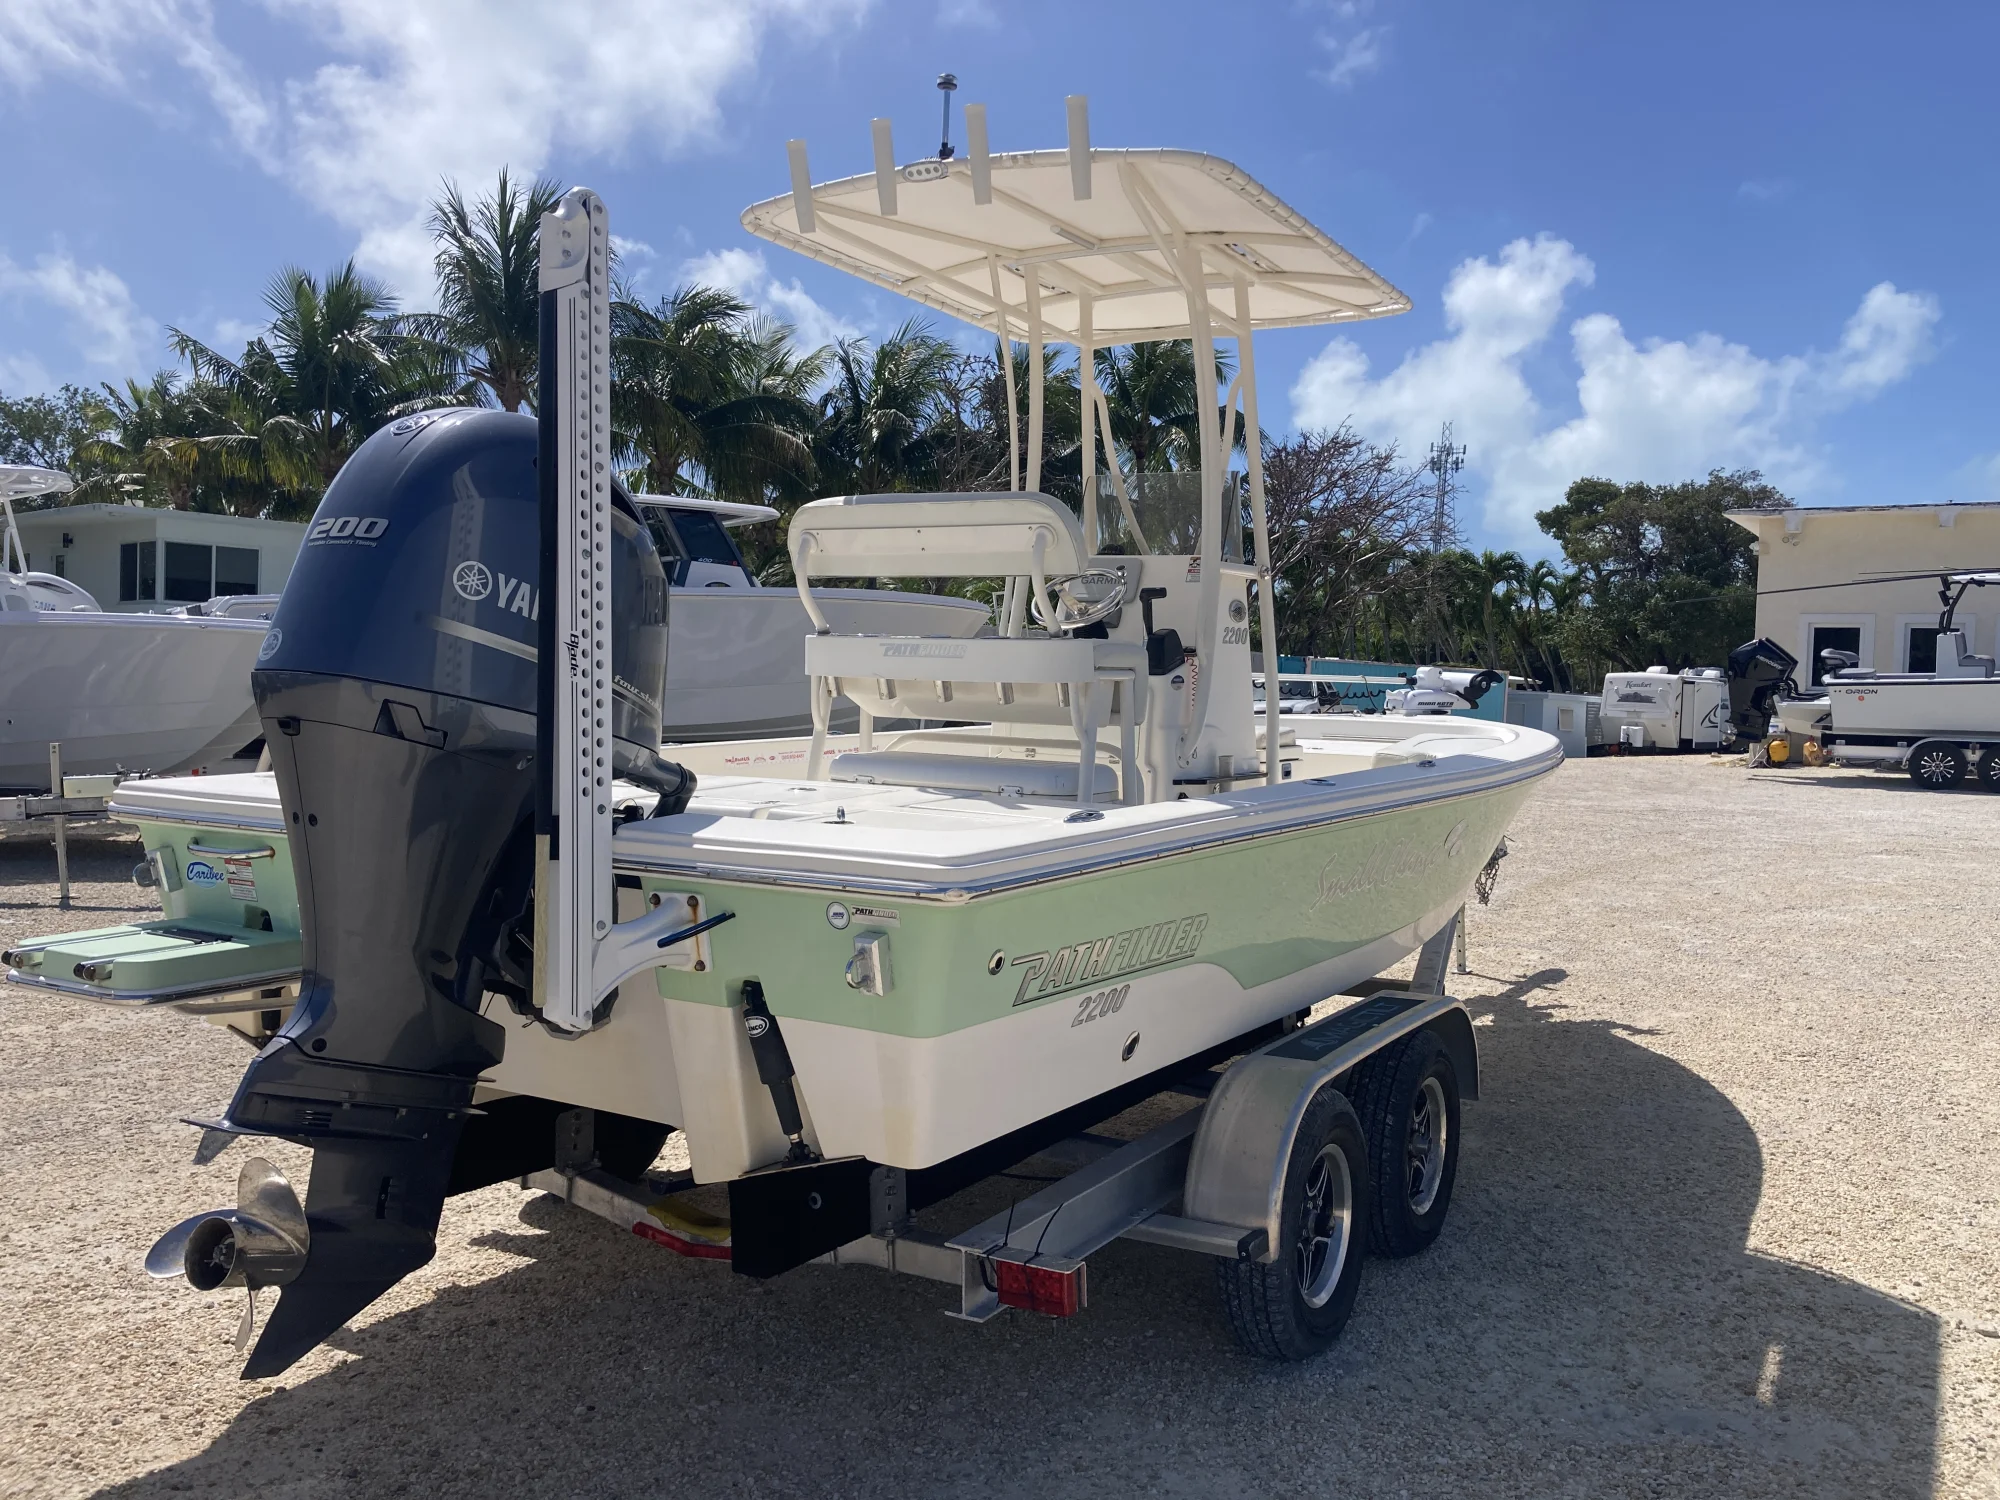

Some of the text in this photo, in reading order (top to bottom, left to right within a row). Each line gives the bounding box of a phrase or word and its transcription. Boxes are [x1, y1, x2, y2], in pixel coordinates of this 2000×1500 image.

[309, 517, 389, 540] 200
[1222, 626, 1249, 645] 2200
[879, 643, 968, 659] PATHFINDER
[1625, 681, 1652, 689] Komfort
[187, 861, 225, 881] Caribee
[1011, 912, 1210, 1008] PATHFINDER
[1070, 983, 1131, 1028] 2200
